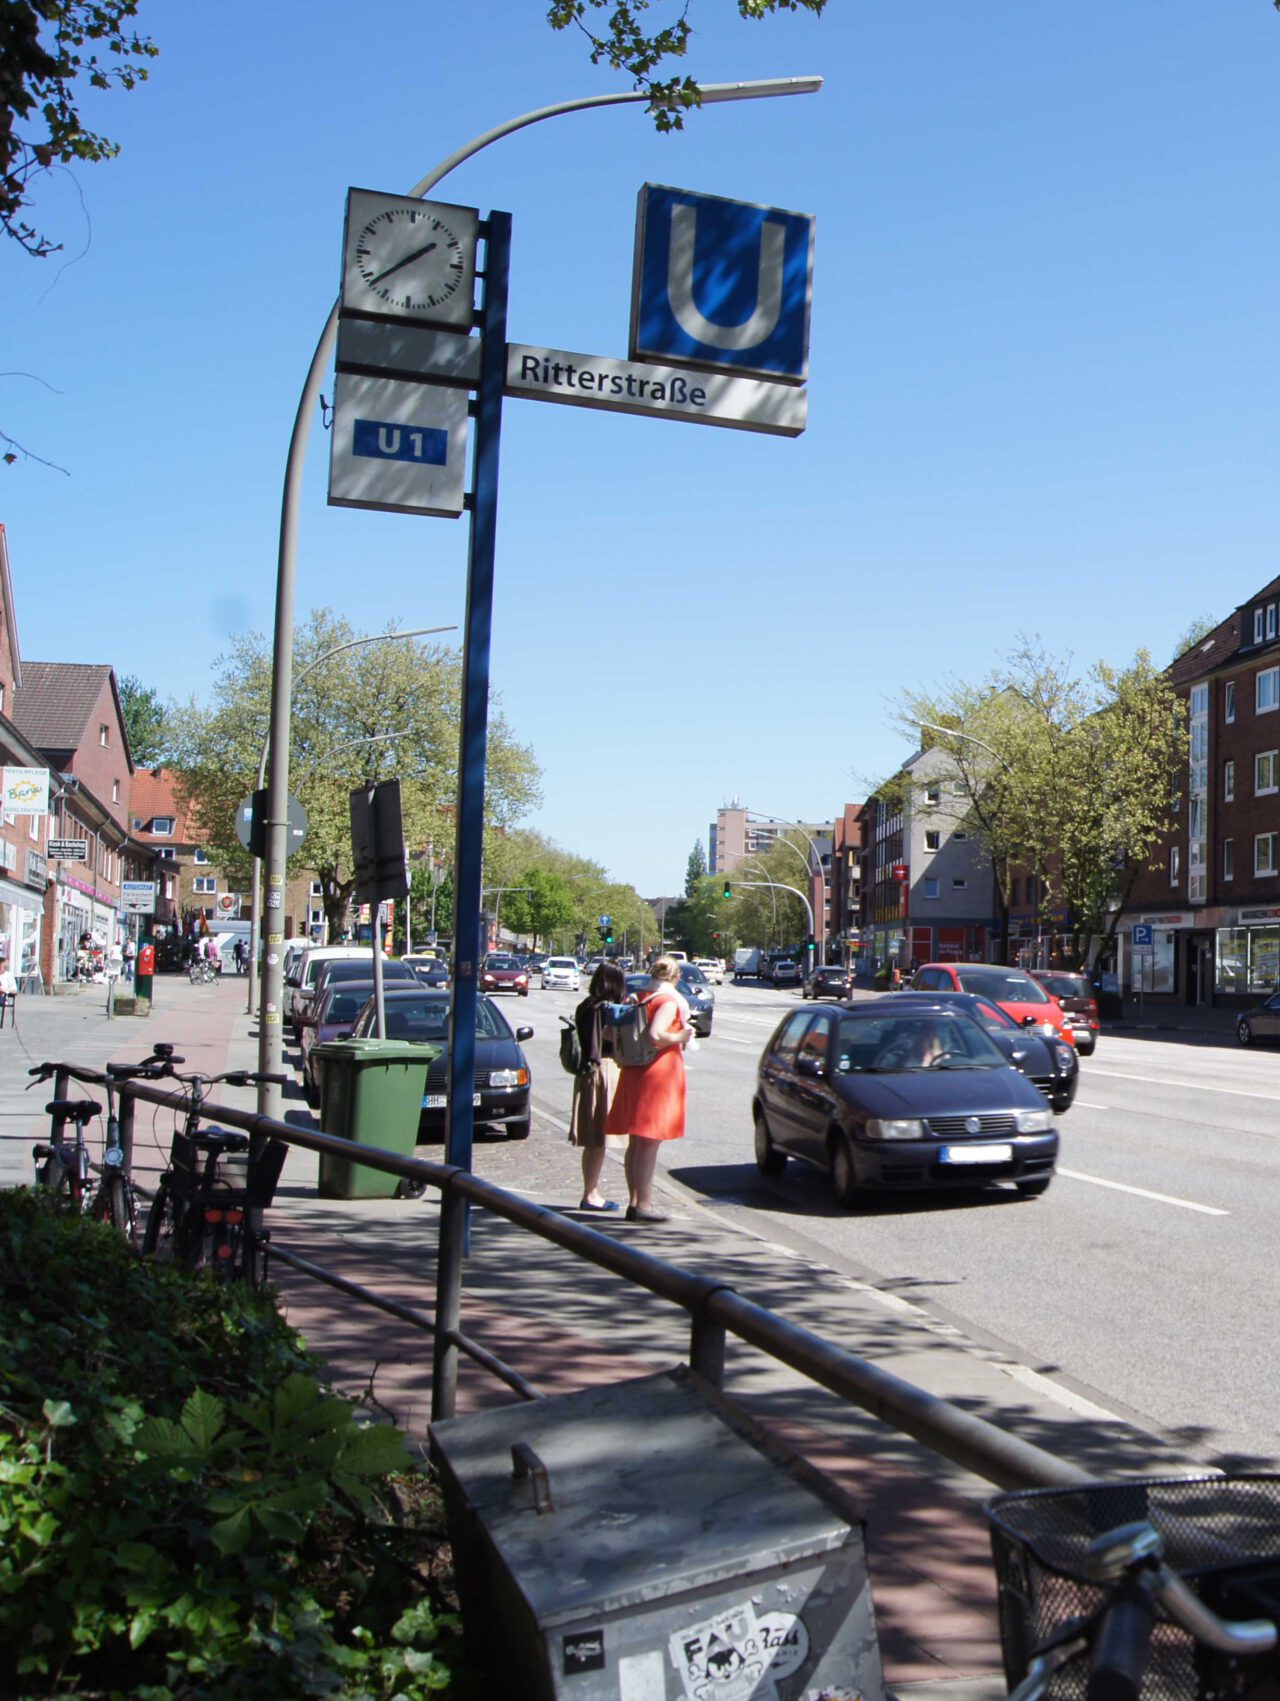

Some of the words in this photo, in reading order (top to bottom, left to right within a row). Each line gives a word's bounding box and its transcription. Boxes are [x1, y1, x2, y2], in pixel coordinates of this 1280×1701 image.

[667, 203, 786, 351] U
[520, 355, 706, 407] Ritterstraße
[1136, 928, 1147, 942] P
